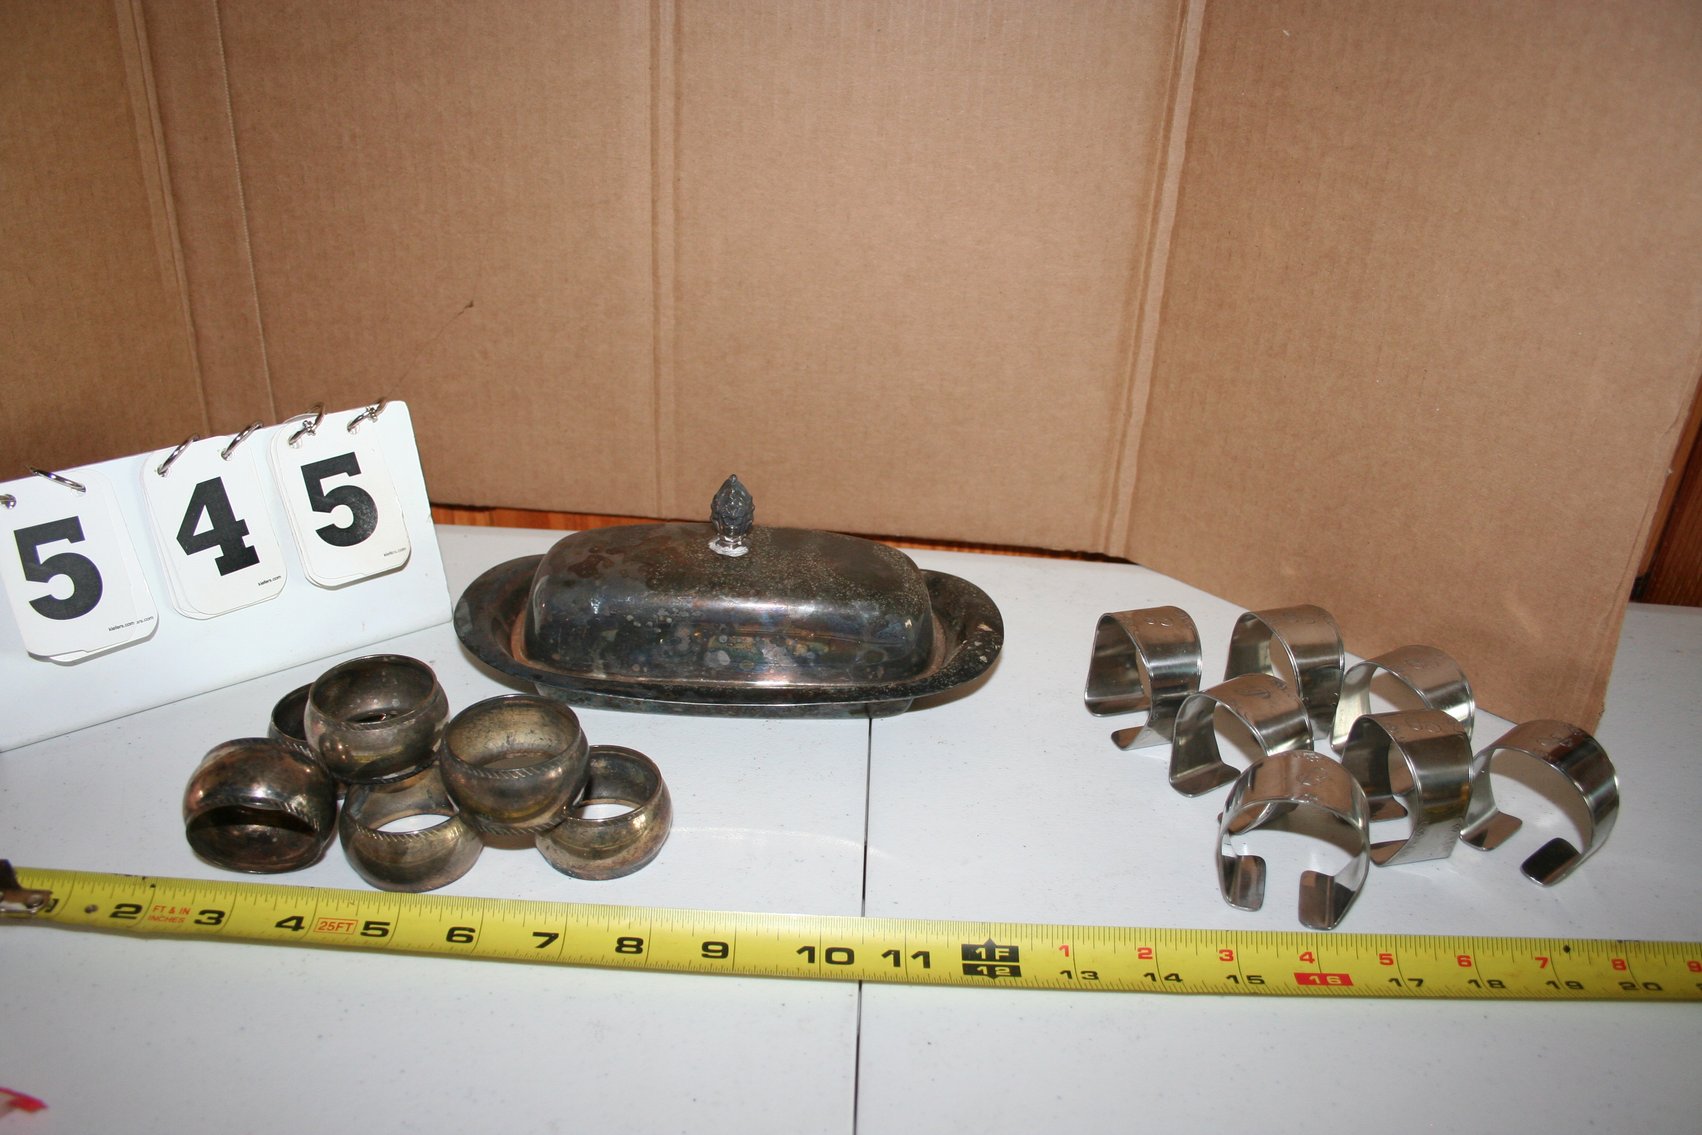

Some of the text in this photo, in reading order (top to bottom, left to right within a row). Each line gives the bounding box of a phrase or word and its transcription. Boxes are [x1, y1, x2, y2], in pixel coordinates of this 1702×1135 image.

[13, 451, 379, 620] 5 4 5
[147, 914, 186, 924] INCHES
[152, 904, 167, 914] FT
[178, 906, 192, 916] IN
[317, 920, 354, 933] 25FT
[109, 903, 143, 920] 2
[194, 909, 226, 926] 3
[275, 915, 305, 932] 4
[360, 920, 391, 938] 5
[445, 926, 476, 944] 6
[531, 931, 560, 949] 7
[615, 936, 644, 955] 8
[701, 940, 730, 960] 9
[796, 944, 856, 967] 10
[881, 948, 931, 970] 11
[1059, 944, 1071, 958] 1
[1136, 946, 1154, 961] 2
[1218, 949, 1235, 962] 3
[1299, 951, 1316, 964] 4
[1378, 953, 1395, 966] 5
[1456, 954, 1473, 968] 6
[1535, 956, 1550, 969] 7
[1611, 958, 1627, 971] 8
[1686, 960, 1702, 973] 9
[977, 965, 1664, 992] 12 13 14 15 16 17 18 19 20
